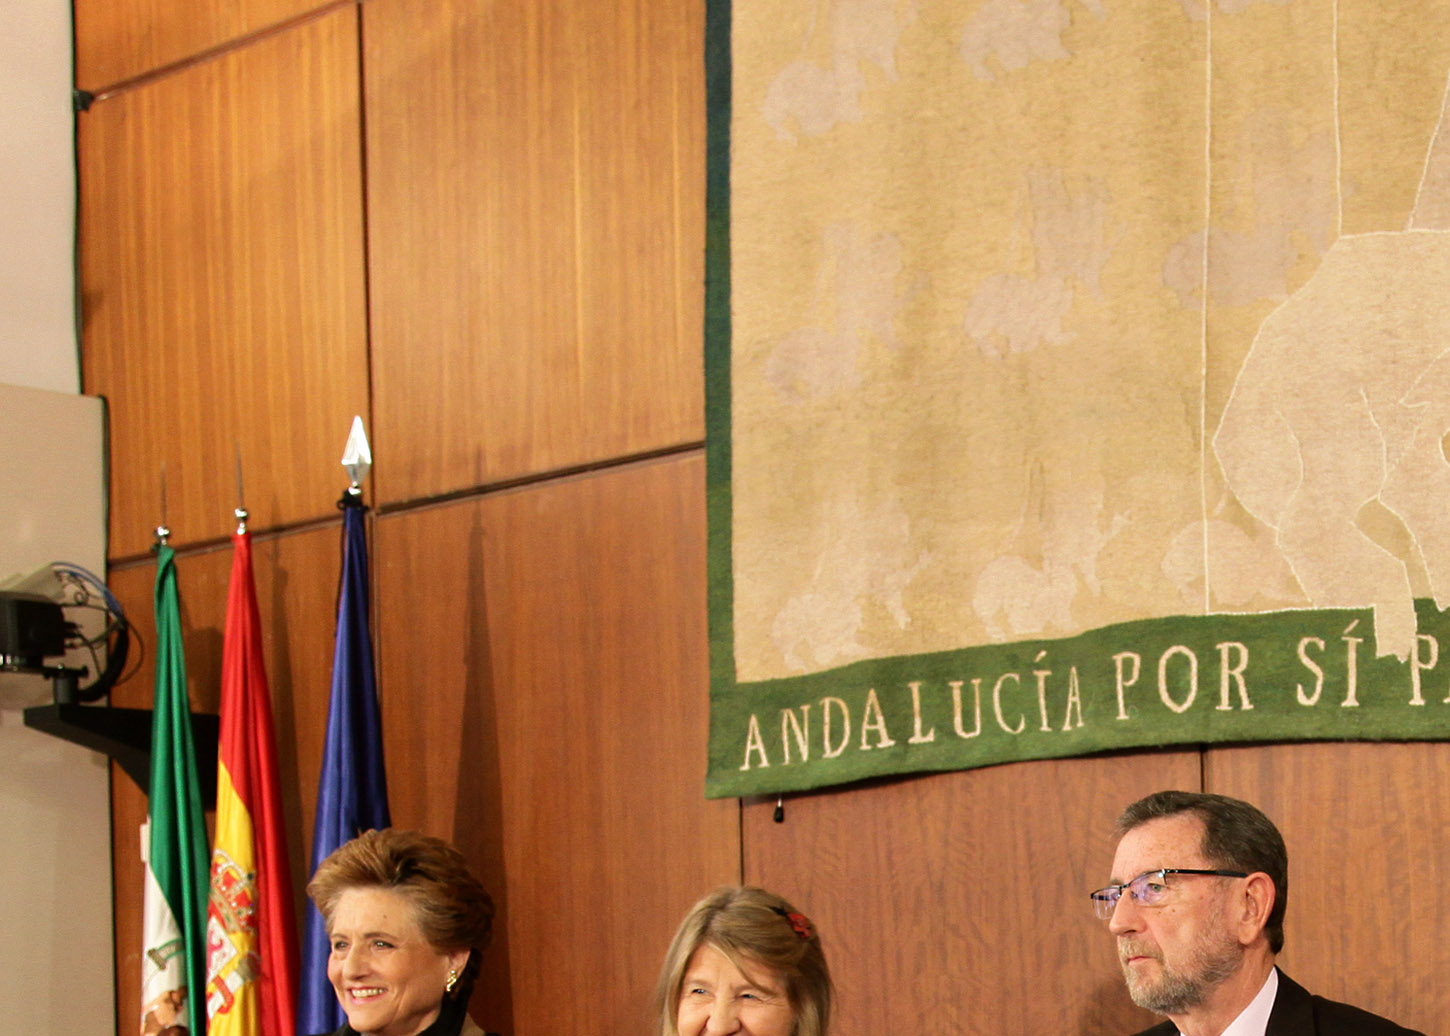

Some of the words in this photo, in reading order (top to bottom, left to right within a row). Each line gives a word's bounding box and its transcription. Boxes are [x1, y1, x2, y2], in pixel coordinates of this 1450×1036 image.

[739, 650, 1085, 771] ANDALUCÍA
[1115, 645, 1255, 720] POR
[1297, 619, 1363, 707] SÍ
